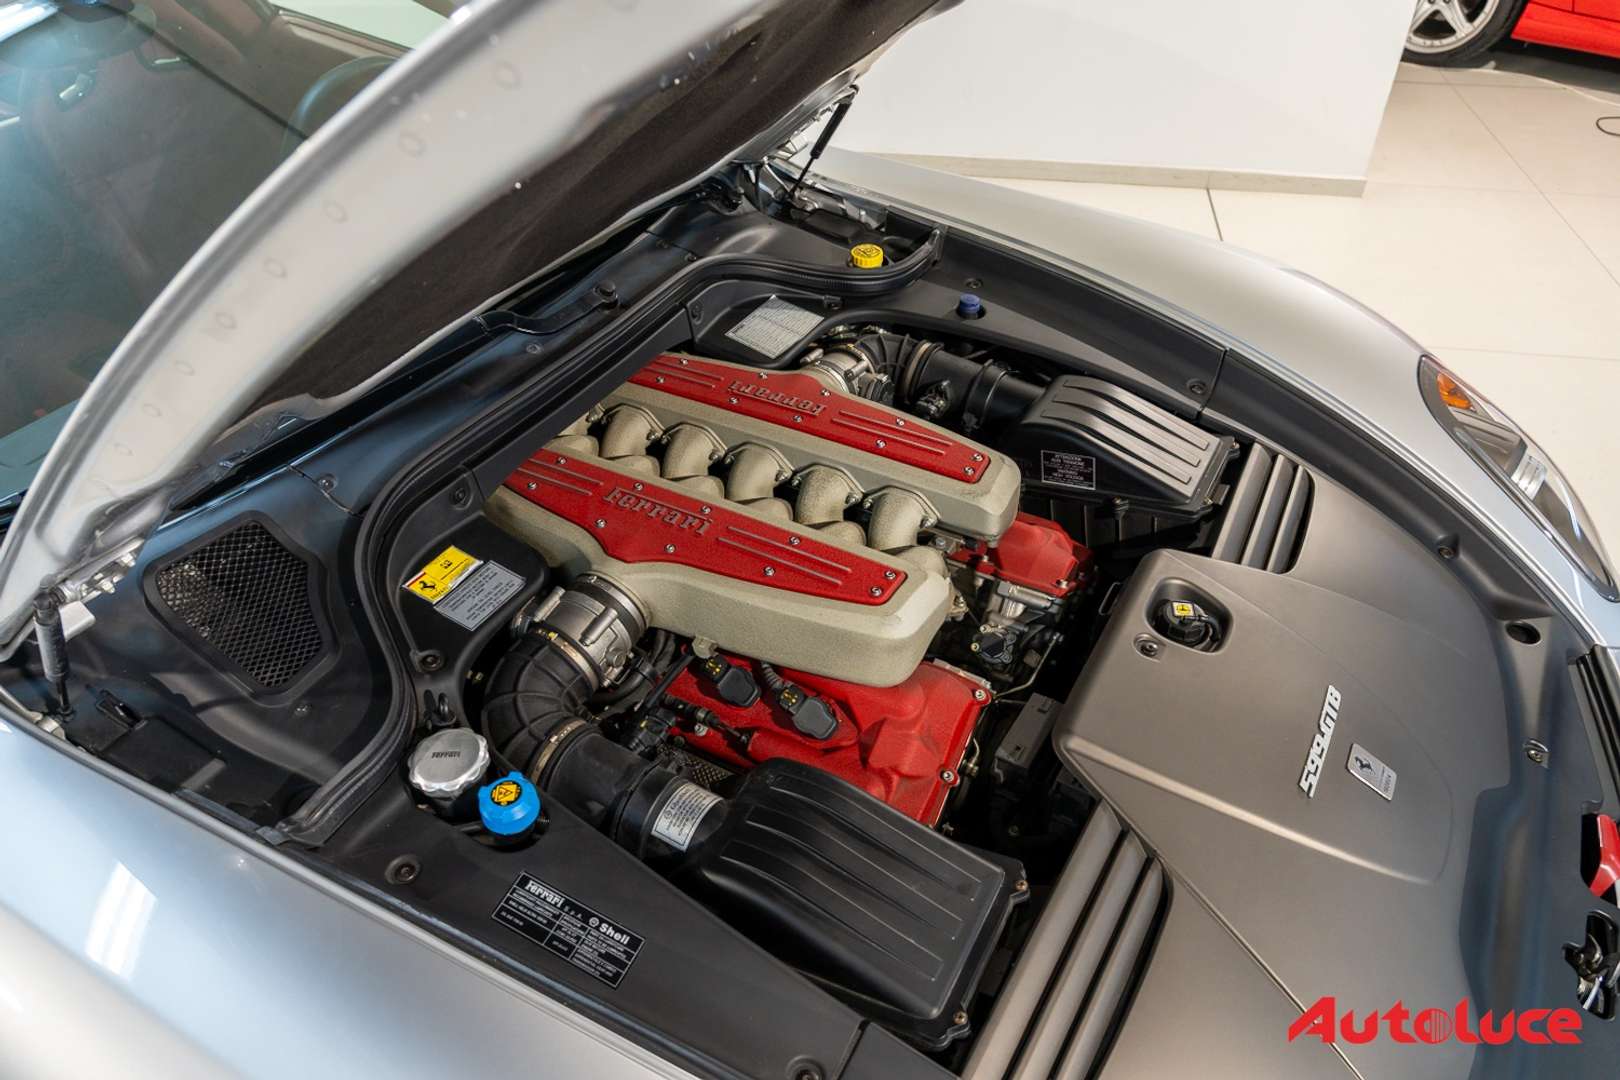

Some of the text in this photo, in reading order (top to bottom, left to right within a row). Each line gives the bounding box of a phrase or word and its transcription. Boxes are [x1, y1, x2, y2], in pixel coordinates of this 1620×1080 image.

[603, 486, 713, 536] Ferrari
[525, 880, 566, 908] Ferrari
[600, 923, 631, 945] Shell
